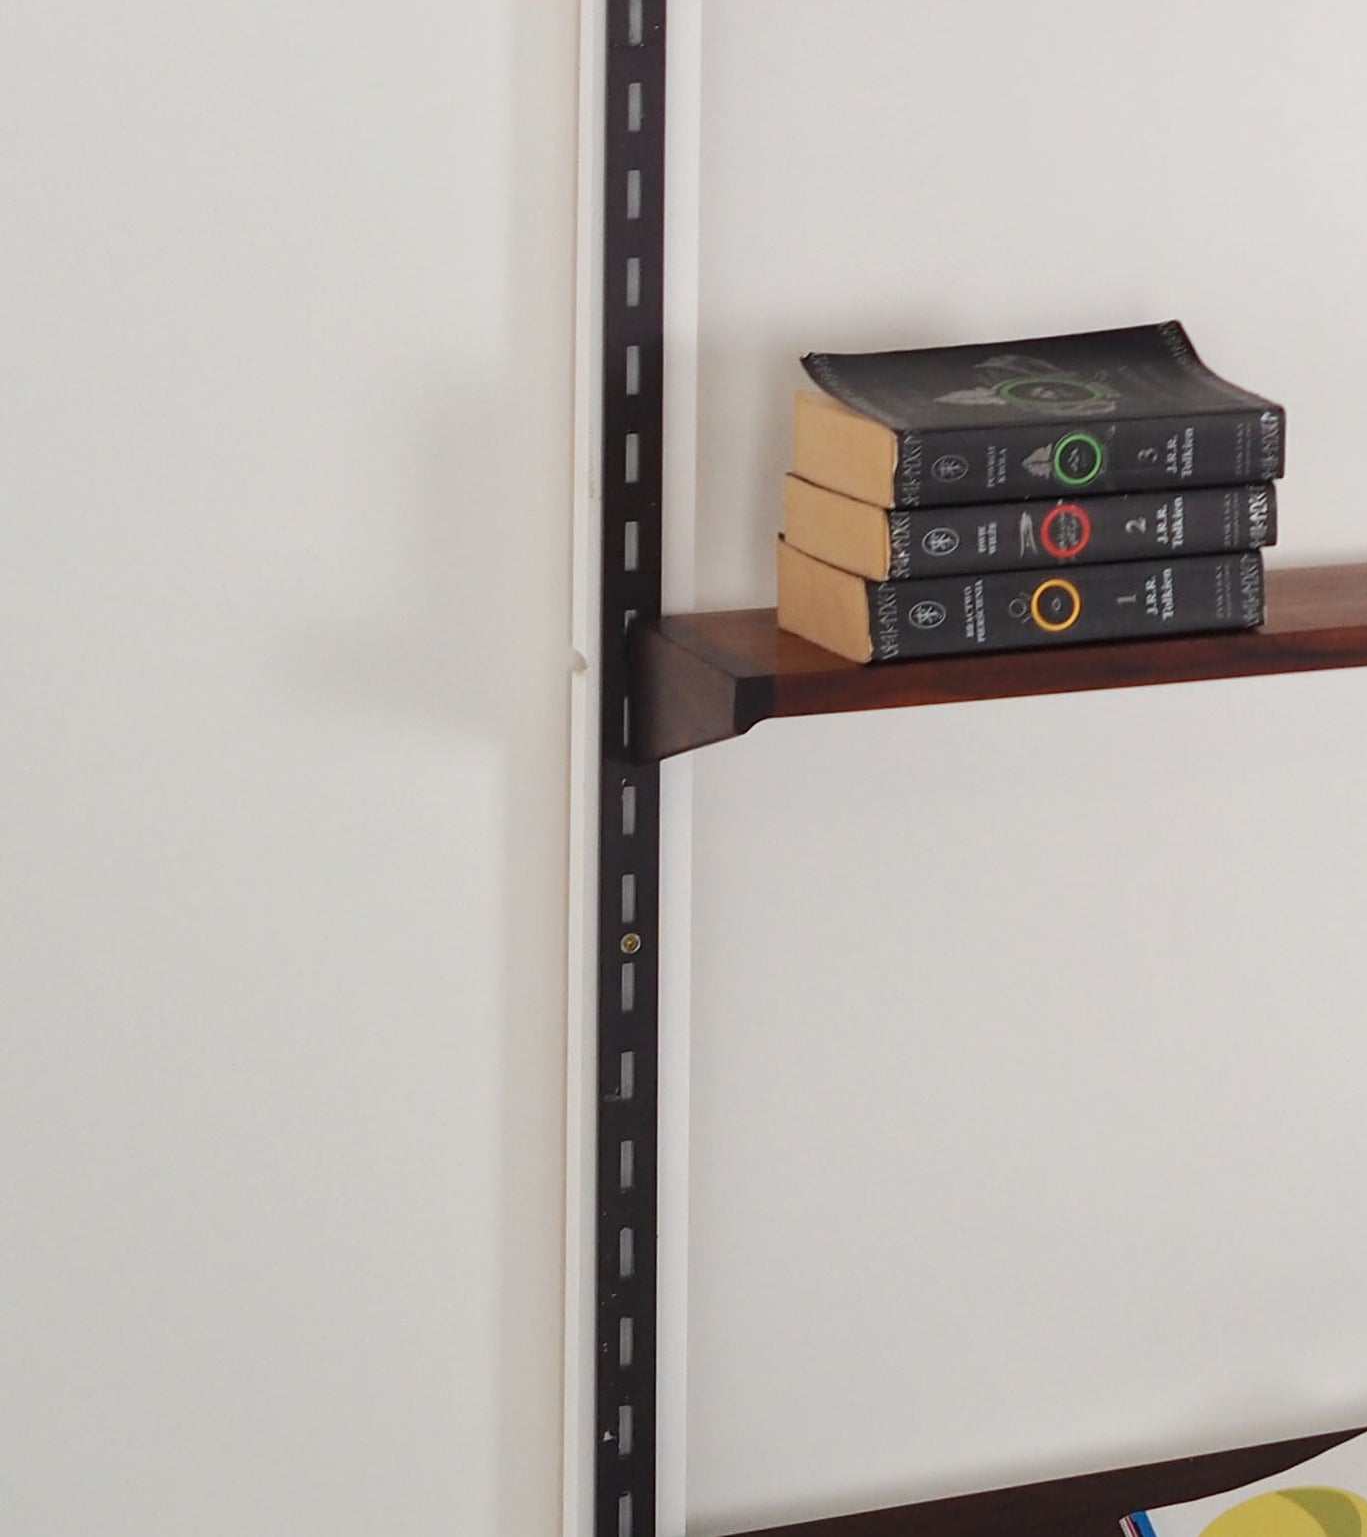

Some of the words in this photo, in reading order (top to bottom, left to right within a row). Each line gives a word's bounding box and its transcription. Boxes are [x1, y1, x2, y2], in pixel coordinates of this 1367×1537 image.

[1137, 447, 1159, 462] 3
[1165, 434, 1178, 475] J.R.R.
[1180, 426, 1195, 479] Tolkien
[1125, 516, 1147, 534] 2
[1155, 503, 1169, 545] J.R.R.
[1170, 496, 1185, 550] Tolkien
[1116, 593, 1137, 606] 1
[1145, 575, 1159, 616] J.R.R.
[1160, 567, 1175, 621] Tolkien
